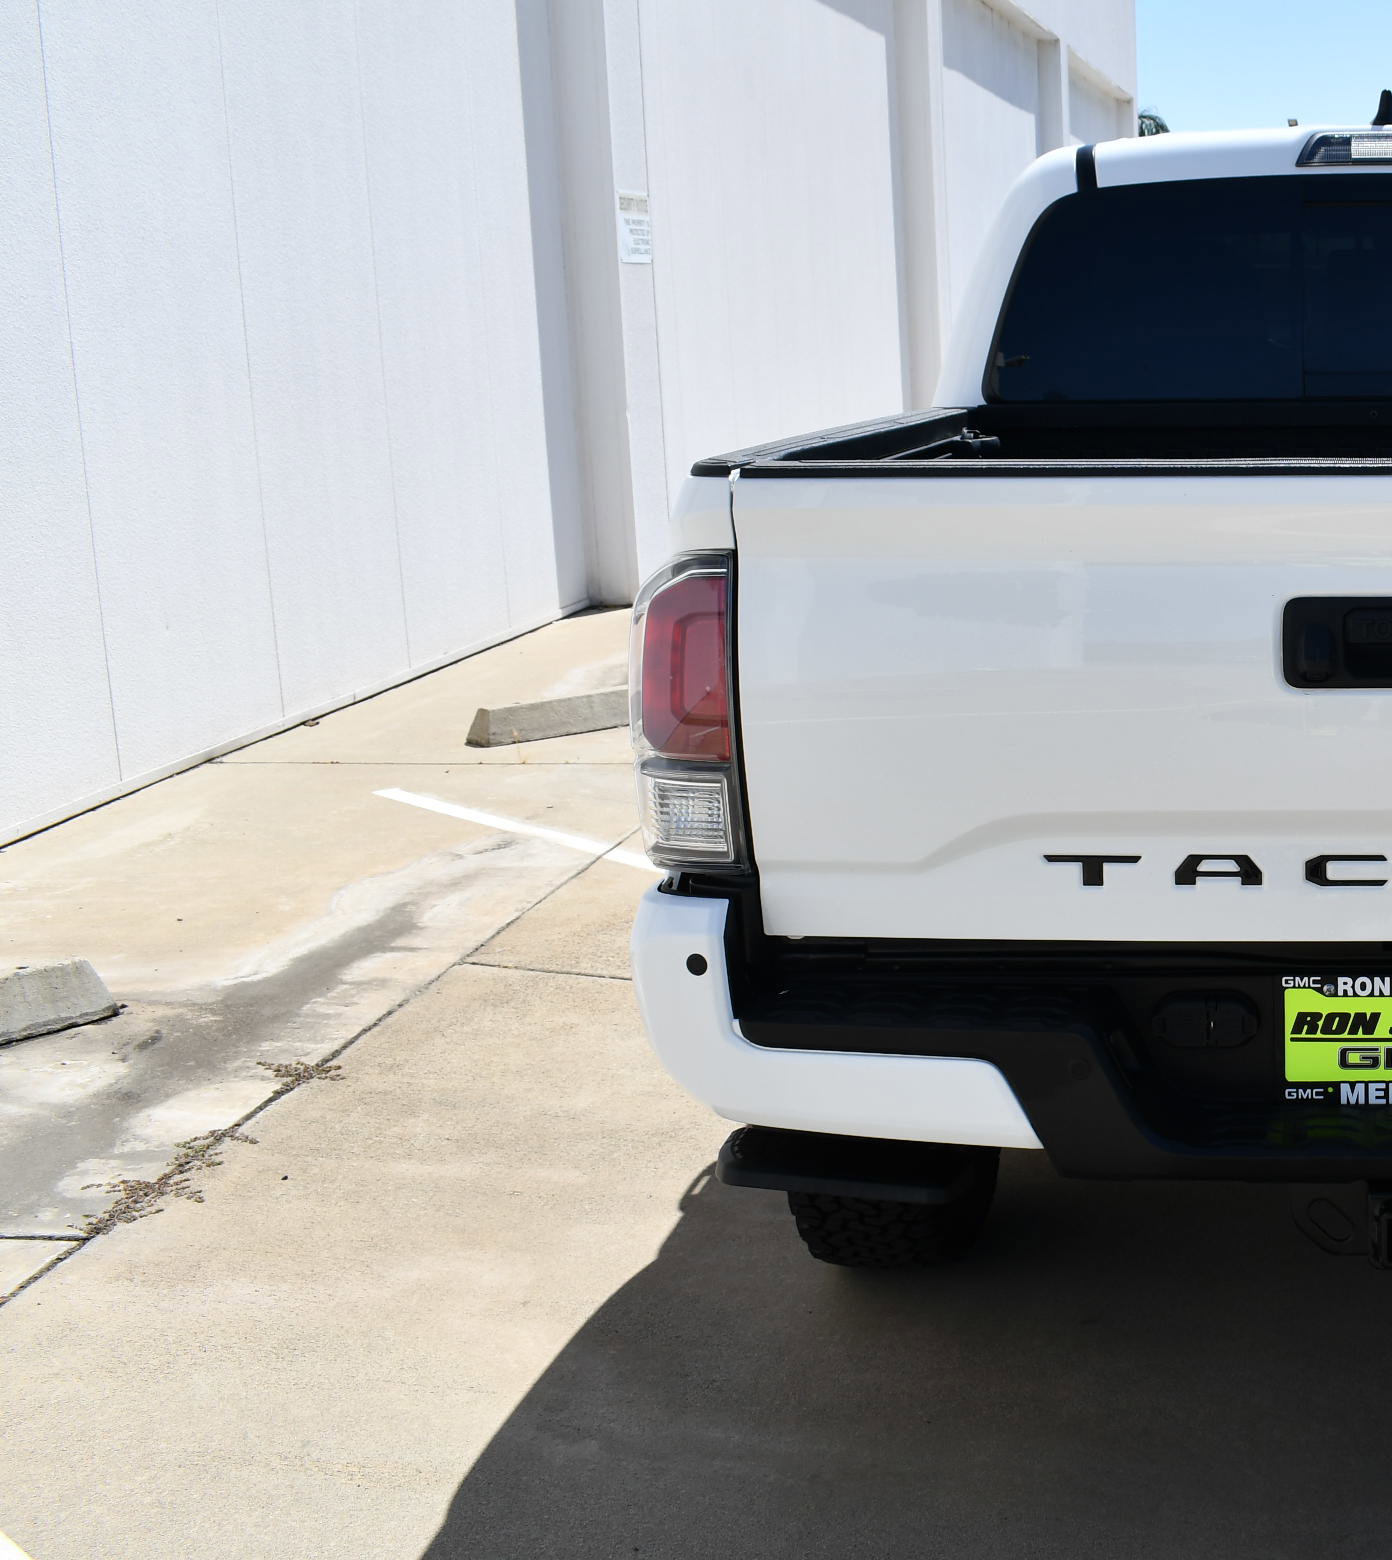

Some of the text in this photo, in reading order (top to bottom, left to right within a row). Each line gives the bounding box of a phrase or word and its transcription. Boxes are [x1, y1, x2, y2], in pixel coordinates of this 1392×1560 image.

[1282, 976, 1322, 988] GMC
[1337, 977, 1391, 997] RON
[1290, 1012, 1382, 1036] RON
[1285, 1088, 1324, 1100] GMC
